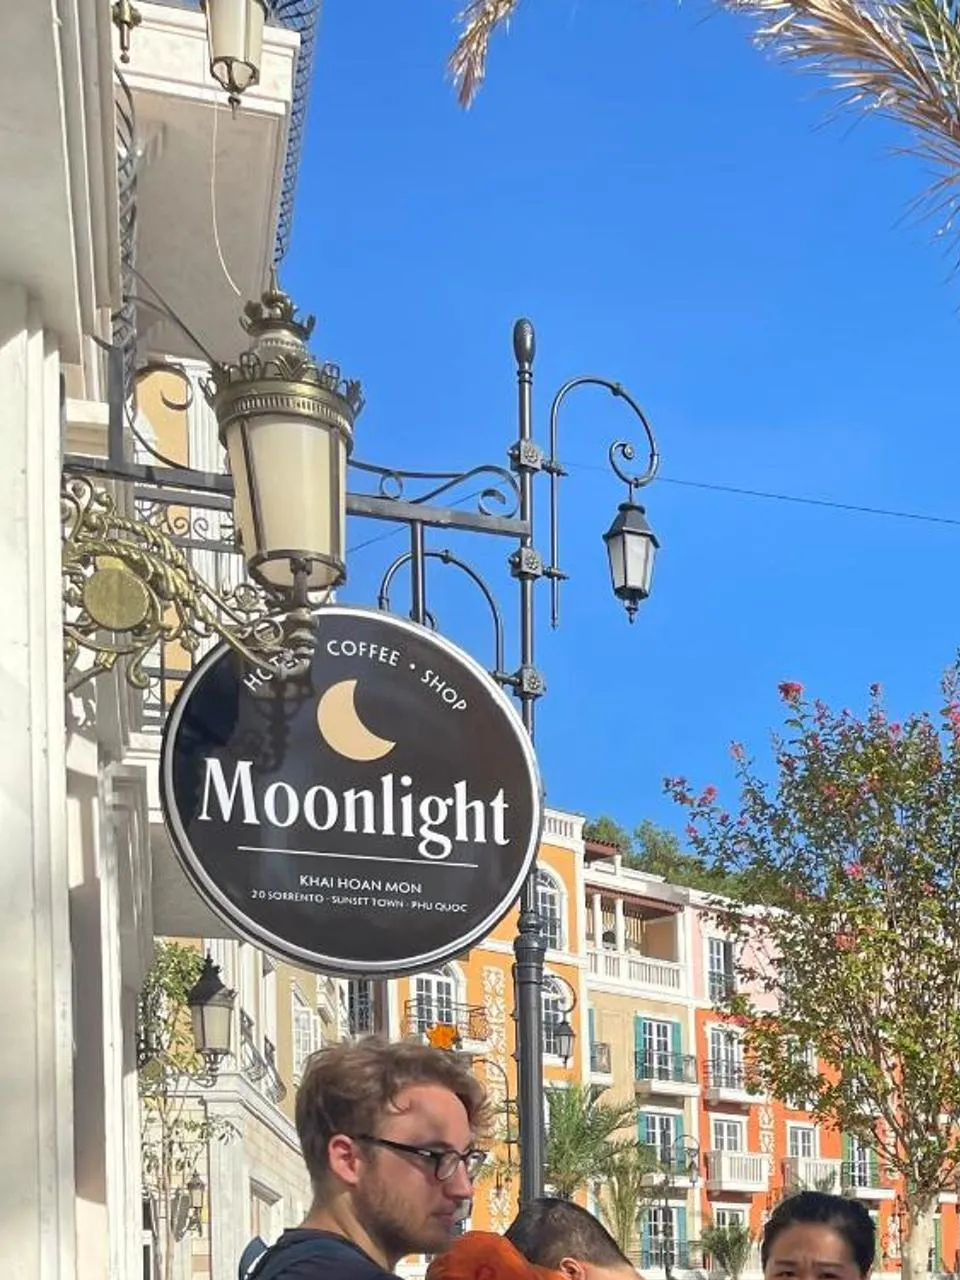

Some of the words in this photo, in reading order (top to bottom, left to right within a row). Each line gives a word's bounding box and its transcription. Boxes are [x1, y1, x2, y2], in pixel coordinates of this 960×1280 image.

[327, 639, 401, 667] COFFEE
[420, 668, 467, 712] SHOP
[197, 757, 510, 860] Moonlight
[251, 889, 266, 899] 20
[268, 891, 324, 904] SORRENTO
[331, 895, 369, 906] SUNSET
[372, 897, 404, 908] TOWN
[411, 900, 433, 911] PHU
[434, 902, 468, 912] QUOC
[299, 874, 334, 889] KHAI
[337, 876, 382, 891] HOAN
[384, 882, 422, 894] MON
